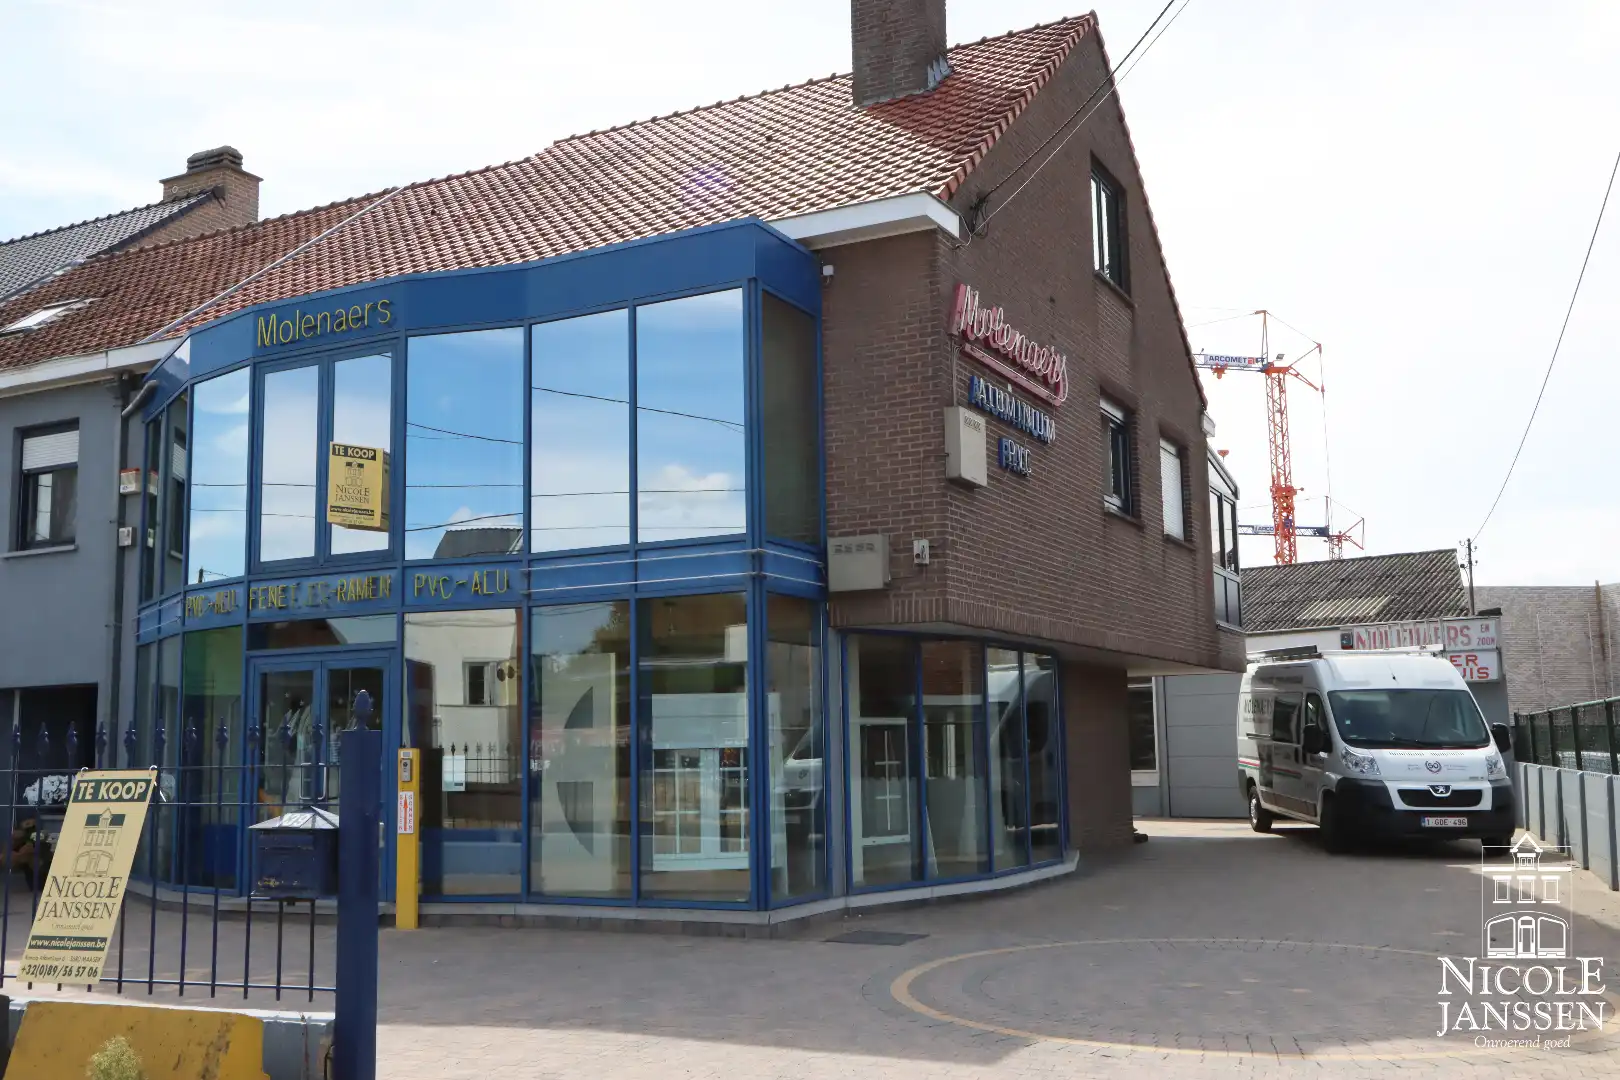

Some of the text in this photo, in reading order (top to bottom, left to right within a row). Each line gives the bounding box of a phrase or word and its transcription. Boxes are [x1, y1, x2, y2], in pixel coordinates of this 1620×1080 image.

[257, 300, 391, 347] Molenaers
[1209, 355, 1247, 364] ARCOMET
[334, 445, 375, 459] TE KOOP
[335, 484, 370, 497] NICOLE
[77, 781, 146, 800] TE KOOP
[45, 876, 122, 898] NICOLE
[37, 901, 117, 921] JANSSEN
[30, 938, 106, 950] www.nicolejanssen.be
[75, 966, 87, 978] 57
[87, 967, 98, 978] 06
